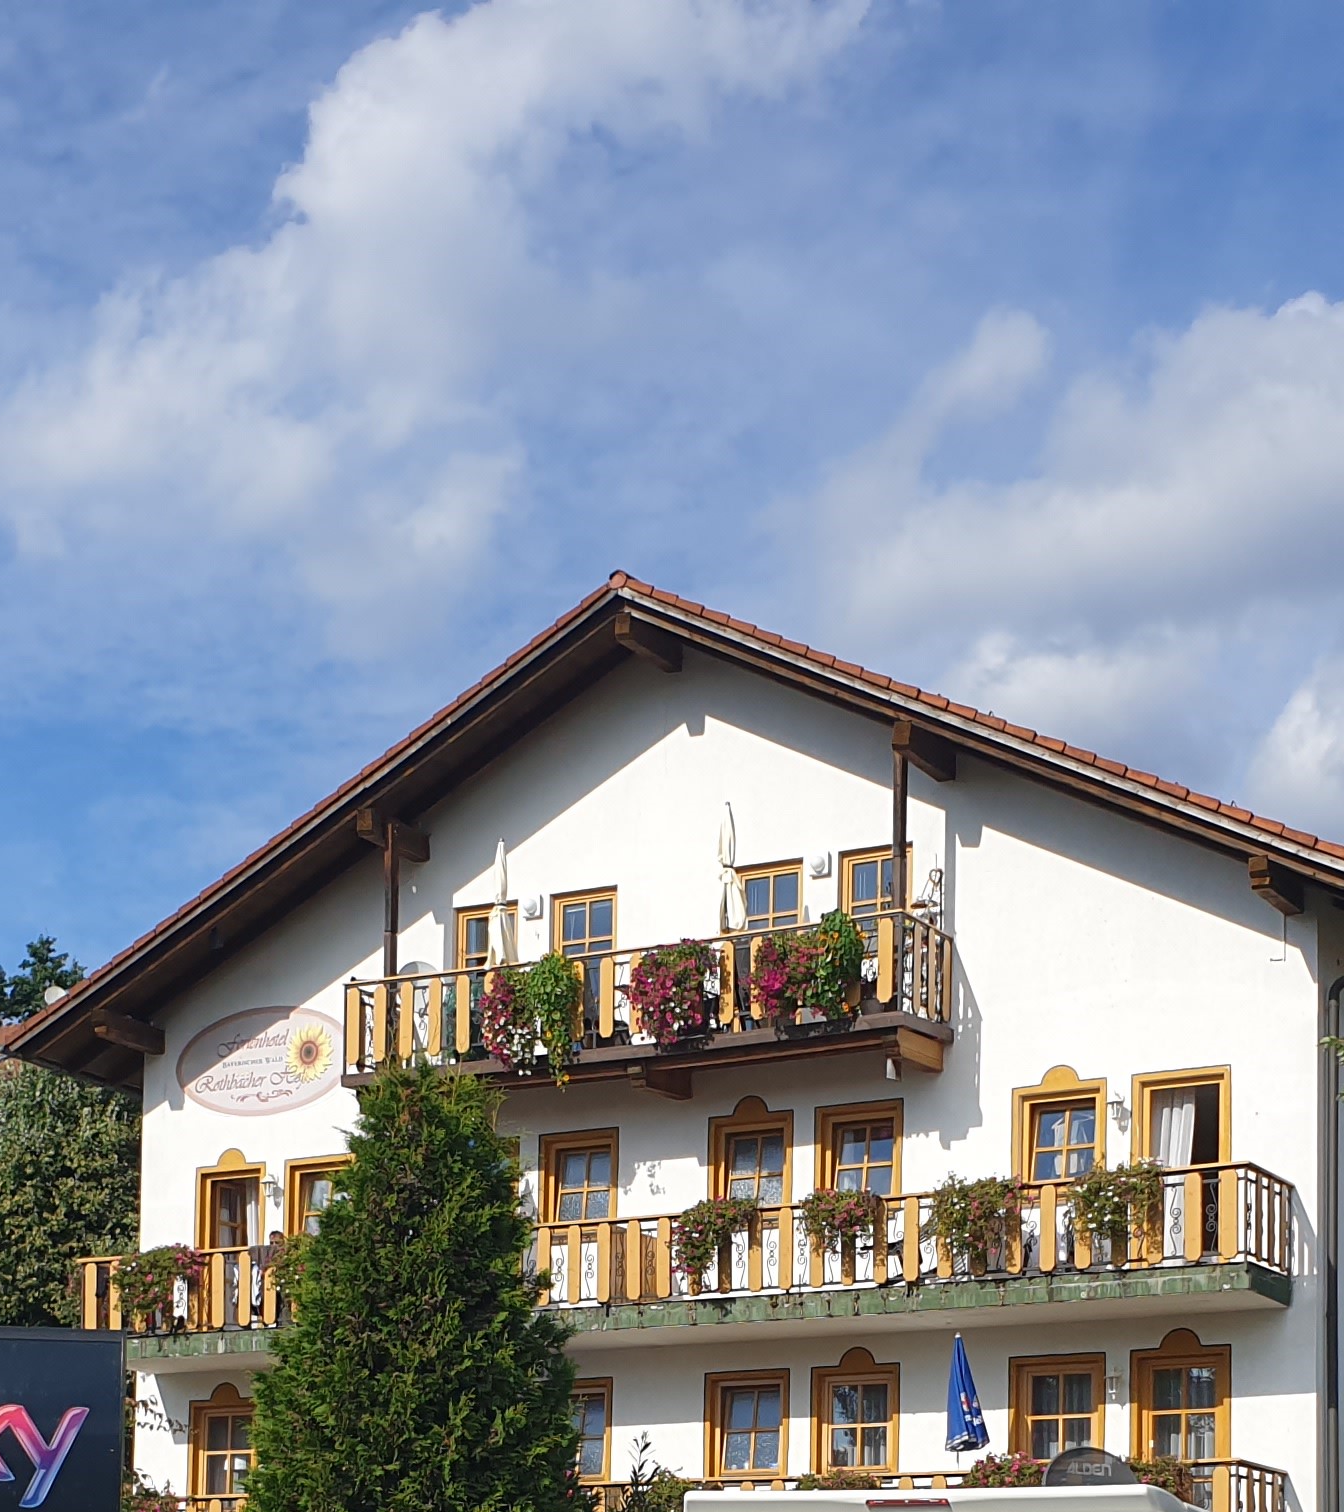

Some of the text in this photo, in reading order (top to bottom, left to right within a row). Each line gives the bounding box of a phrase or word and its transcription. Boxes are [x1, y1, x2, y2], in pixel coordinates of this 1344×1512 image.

[217, 1028, 290, 1058] Ferienhotel
[194, 1071, 266, 1094] Rothbacher
[1067, 1462, 1112, 1477] ALDEN
